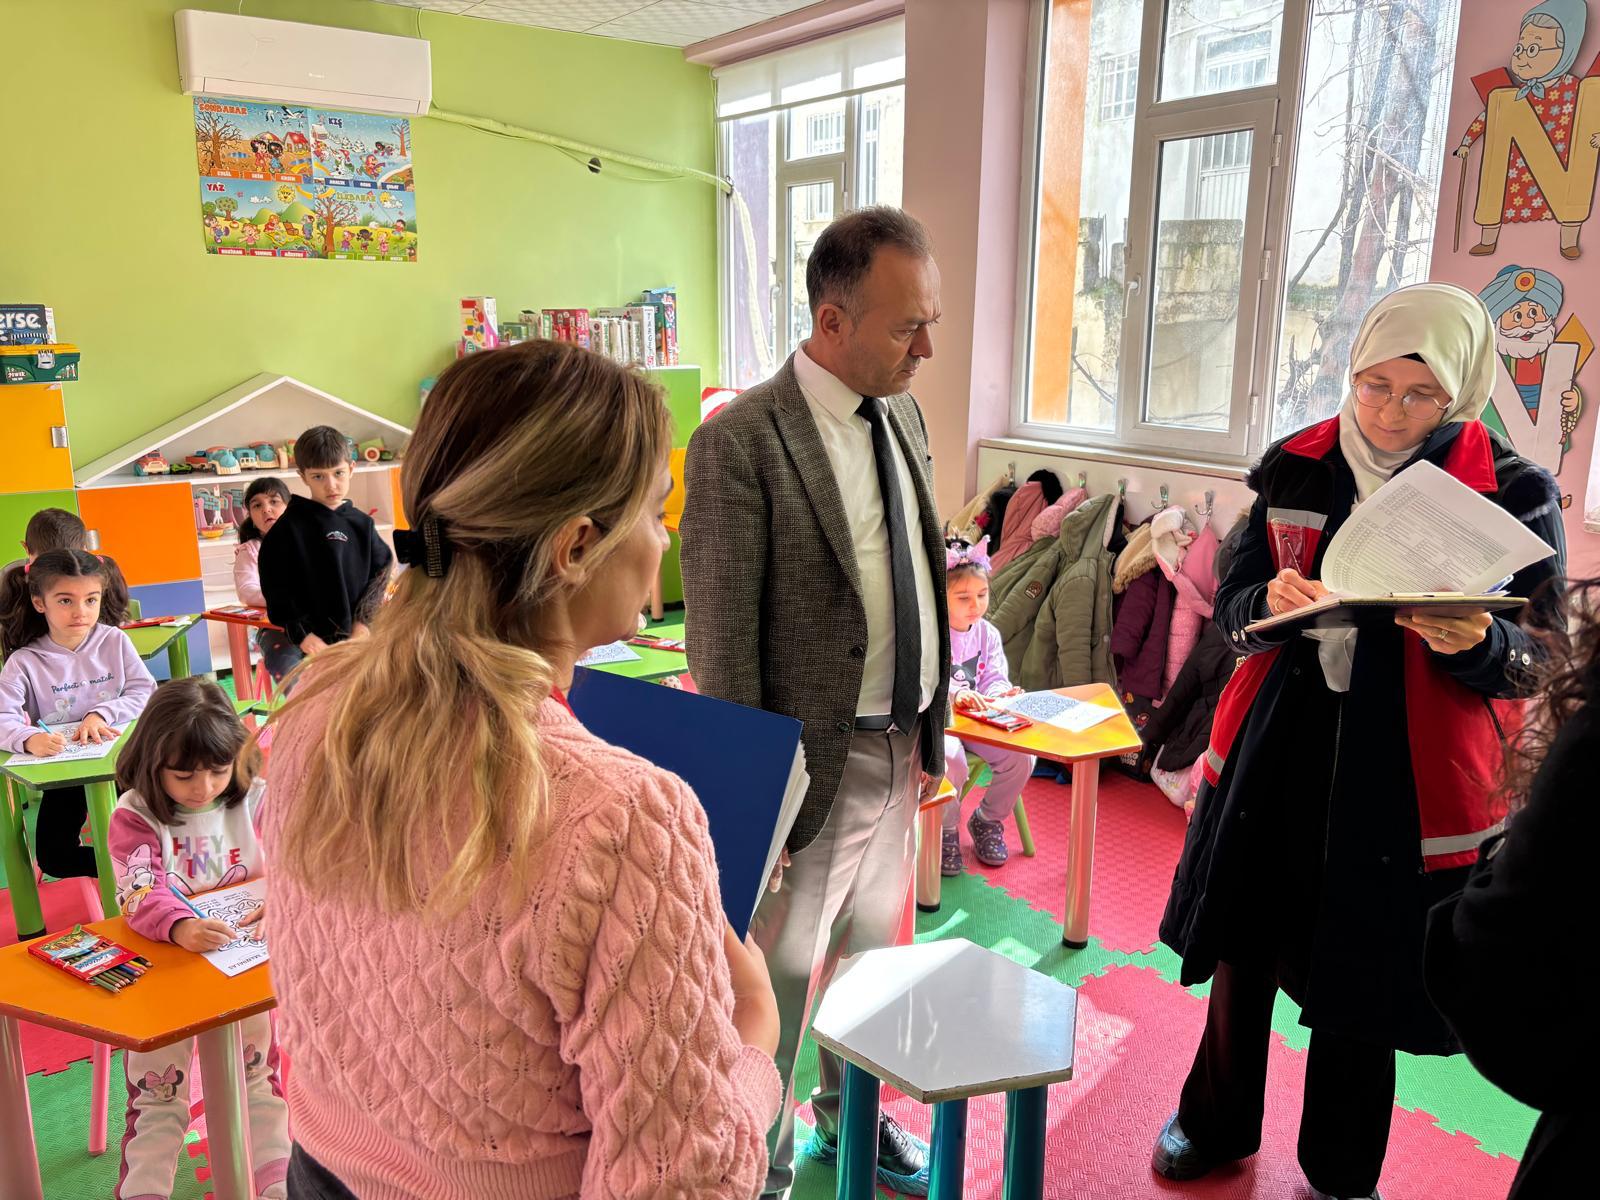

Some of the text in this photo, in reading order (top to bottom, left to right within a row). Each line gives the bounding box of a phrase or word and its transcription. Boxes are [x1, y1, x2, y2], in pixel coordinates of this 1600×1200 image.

[199, 103, 248, 115] SONBAHAR
[1474, 74, 1600, 227] N
[207, 183, 225, 192] YAZ
[51, 673, 114, 694] Perfect match
[173, 835, 224, 857] HEY
